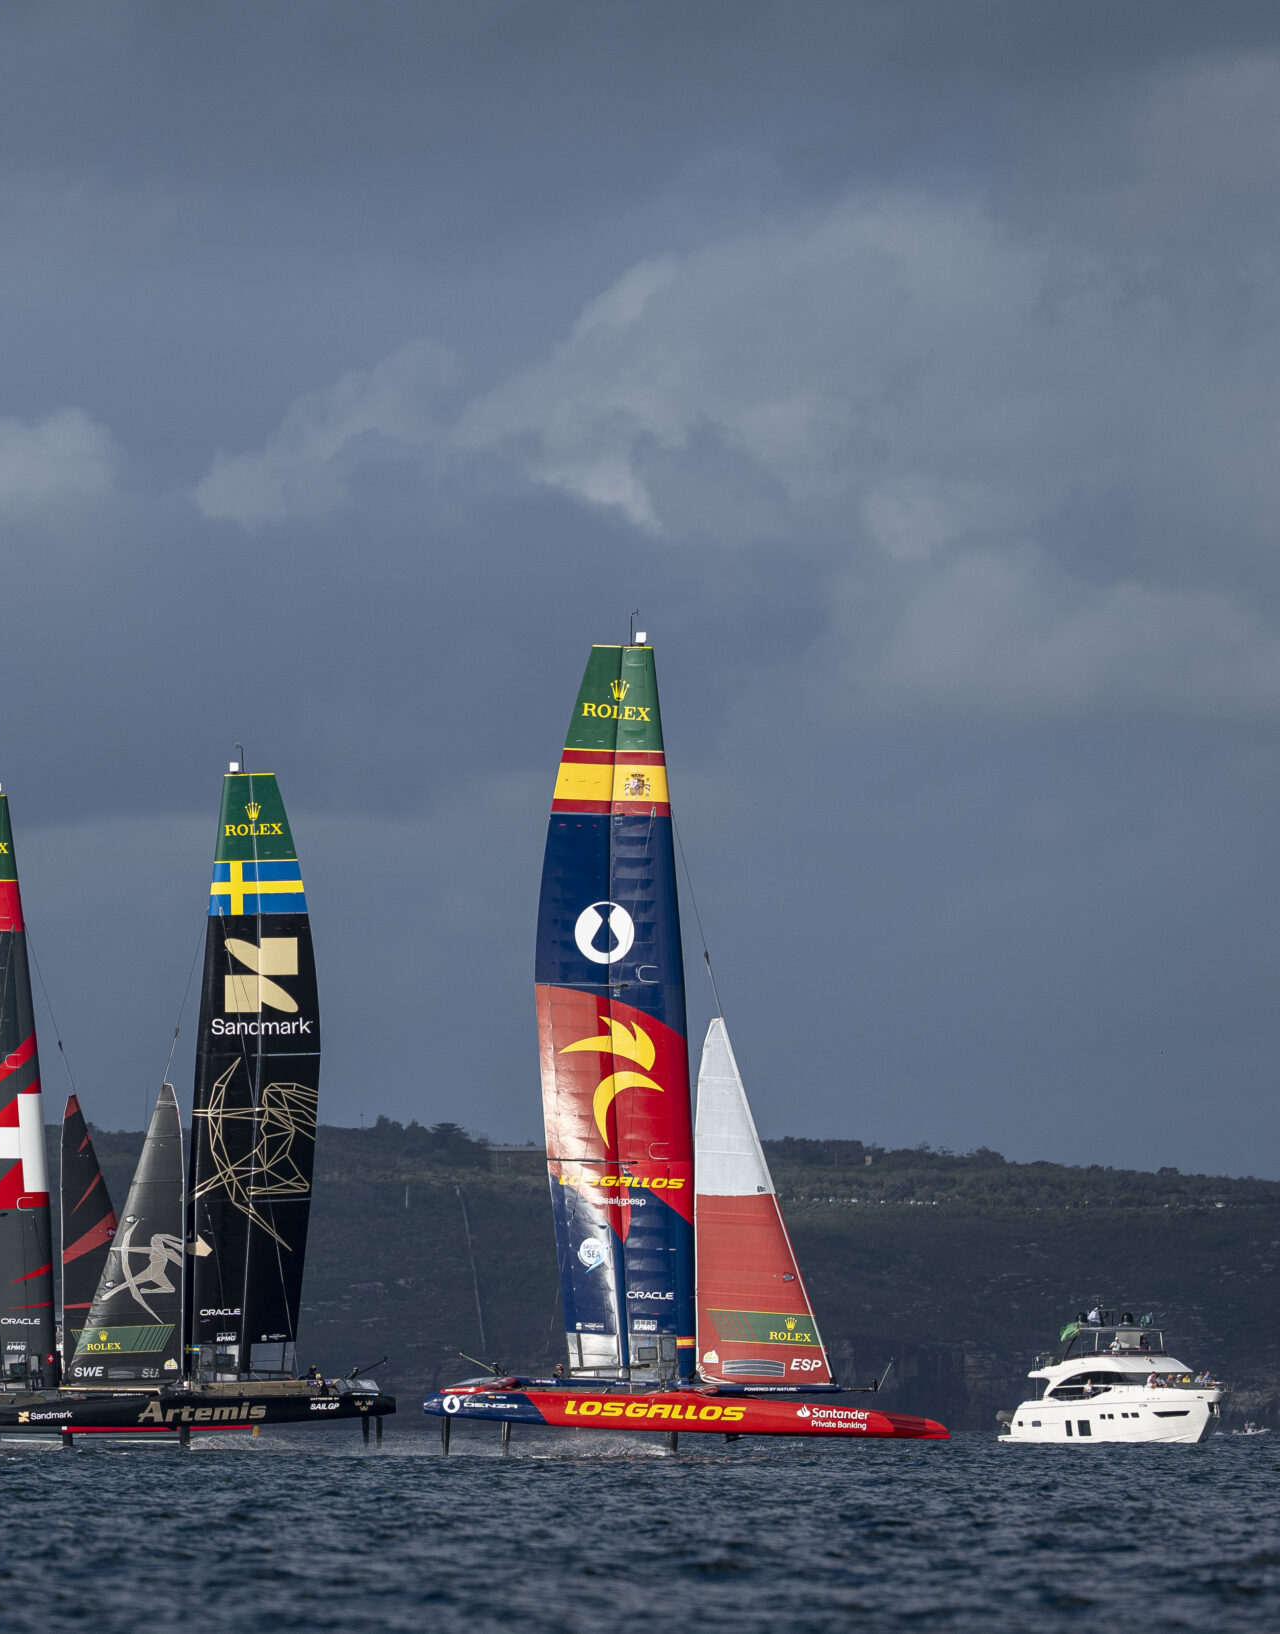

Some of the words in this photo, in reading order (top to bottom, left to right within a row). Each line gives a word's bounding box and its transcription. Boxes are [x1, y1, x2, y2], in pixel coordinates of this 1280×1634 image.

[582, 702, 651, 722] ROLEX
[224, 823, 283, 836] ROLEX
[211, 1018, 312, 1035] Sandmark
[627, 1291, 674, 1300] ORACLE
[200, 1308, 241, 1316] ORACLE
[634, 1323, 656, 1331] KPMG
[769, 1331, 811, 1342] ROLEX
[87, 1342, 121, 1351] ROLEX
[790, 1358, 822, 1371] ESP
[74, 1366, 104, 1377] SWE
[30, 1411, 72, 1420] Sandmark
[137, 1402, 267, 1422] Artemis
[564, 1401, 747, 1421] LOSGALLOS
[812, 1408, 869, 1420] Santander
[811, 1420, 837, 1428] Private
[837, 1421, 867, 1430] Banking
